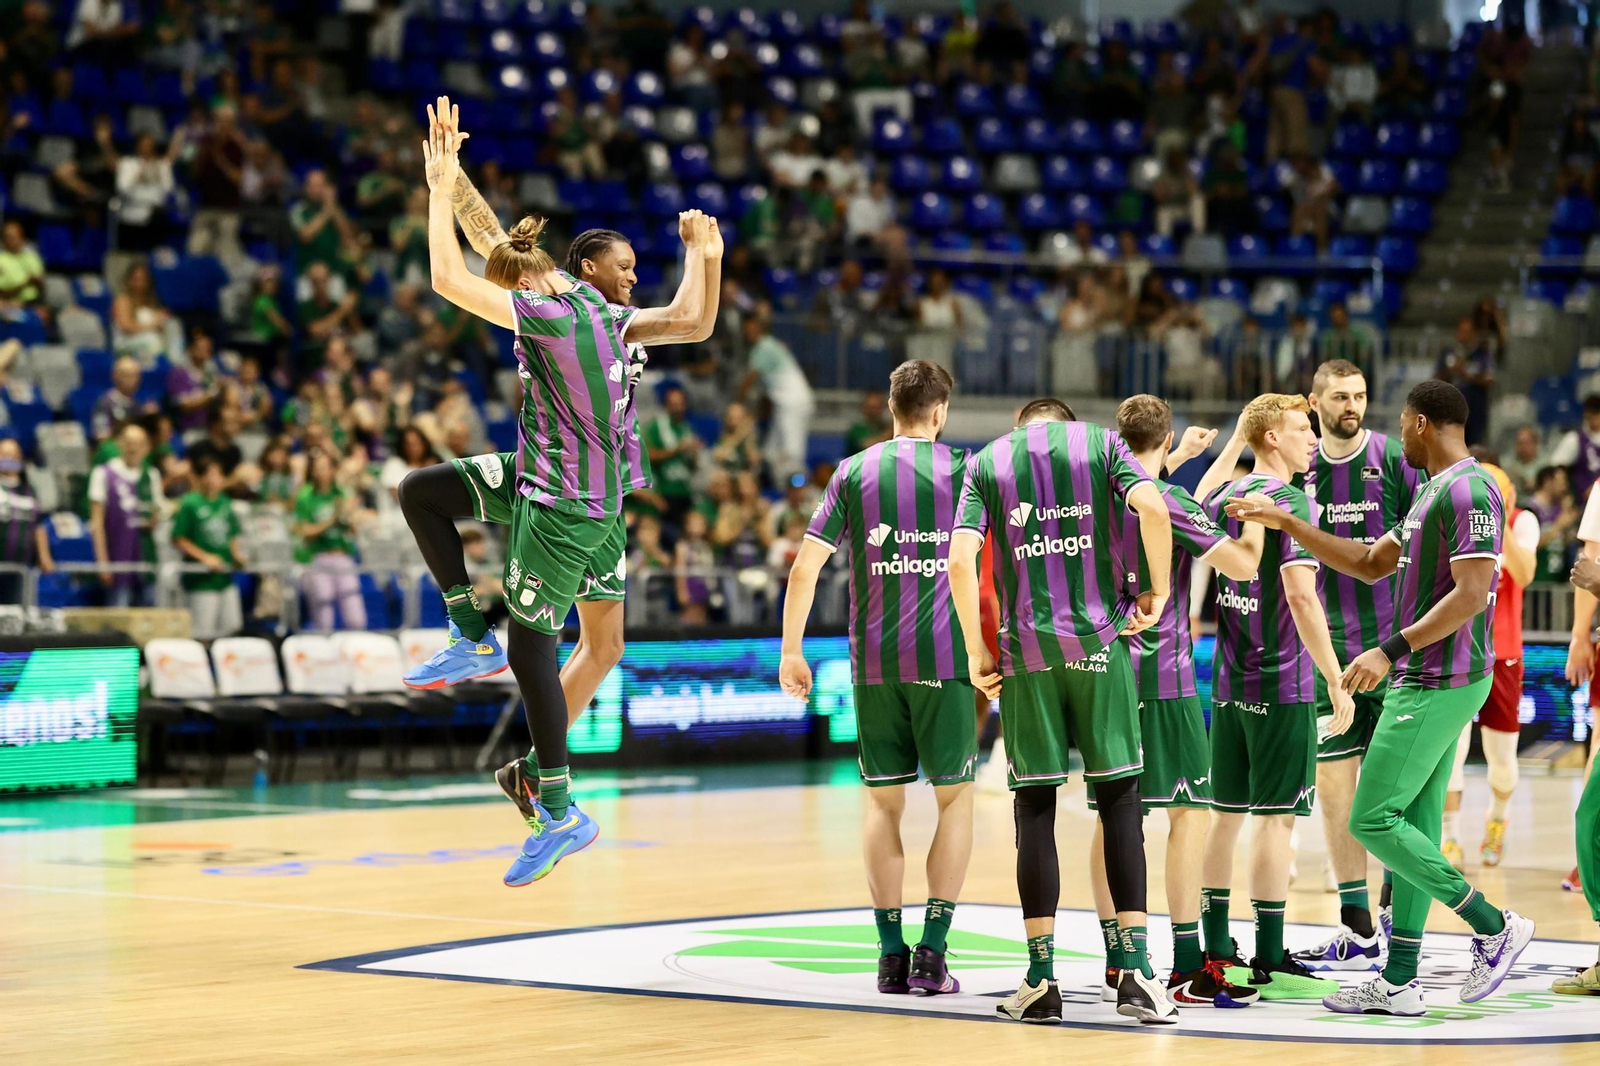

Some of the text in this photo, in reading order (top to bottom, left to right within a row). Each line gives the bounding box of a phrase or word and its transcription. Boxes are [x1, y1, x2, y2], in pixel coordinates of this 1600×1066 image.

[1035, 501, 1093, 521] Unicaja
[1326, 500, 1380, 515] Fundación
[1327, 511, 1365, 525] Unicaja
[1469, 520, 1498, 538] laga
[894, 528, 950, 546] Unicaja
[1089, 652, 1110, 663] SOL
[1065, 660, 1108, 673] MÁLAGA
